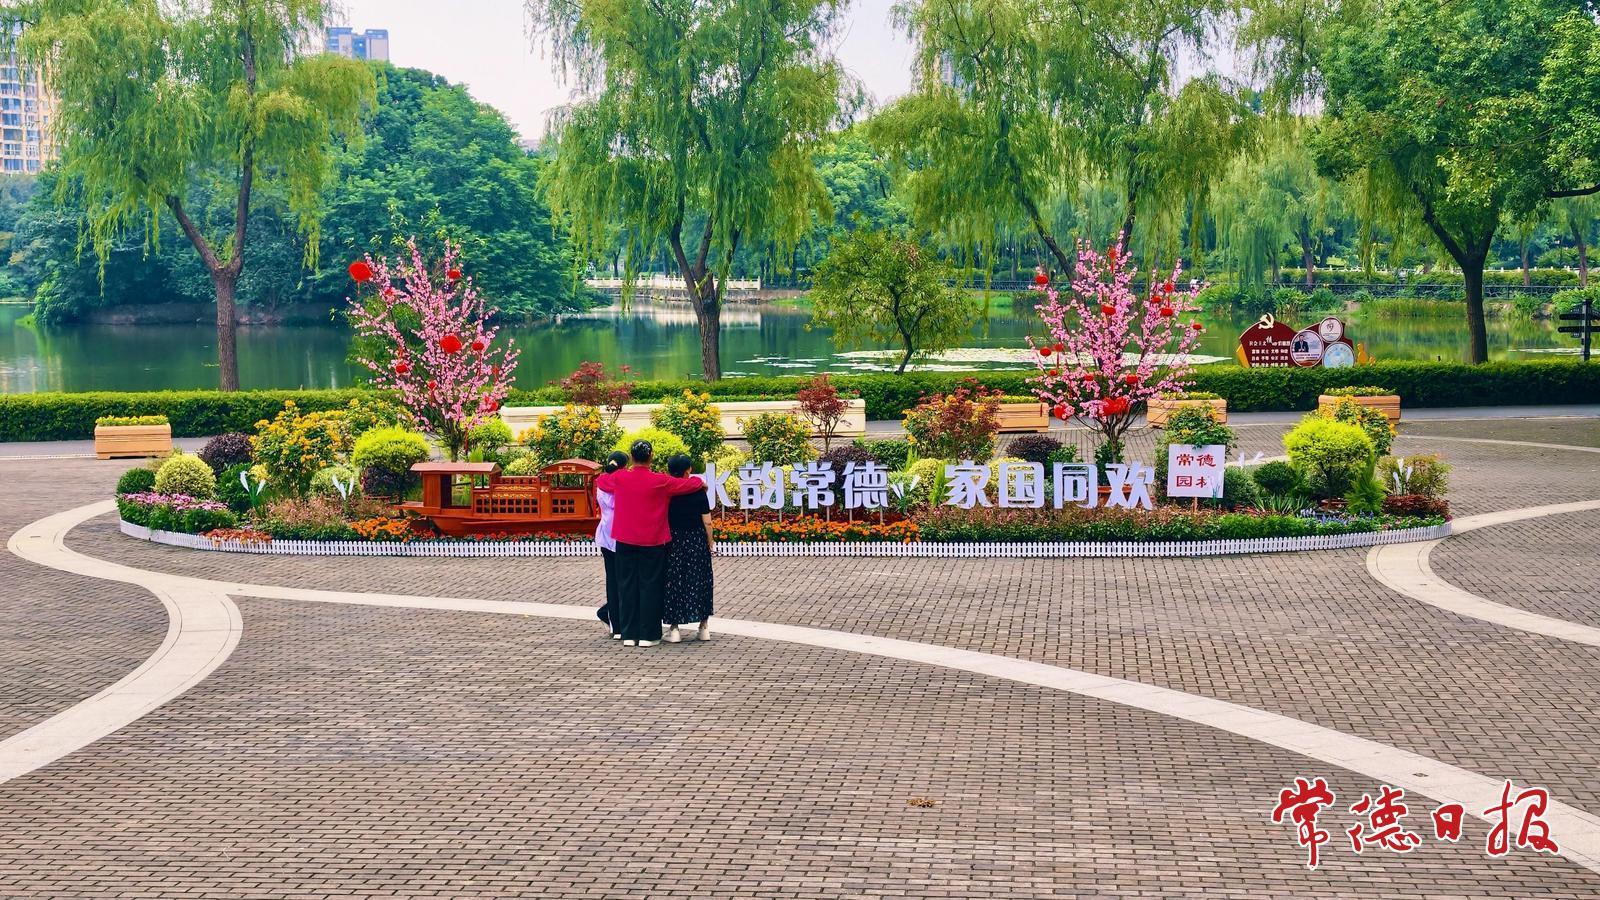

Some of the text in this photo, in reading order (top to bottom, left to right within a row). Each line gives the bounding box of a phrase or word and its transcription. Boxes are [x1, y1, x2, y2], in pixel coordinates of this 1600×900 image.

[1176, 453, 1217, 467] 常德
[944, 460, 1155, 509] 家国同欢
